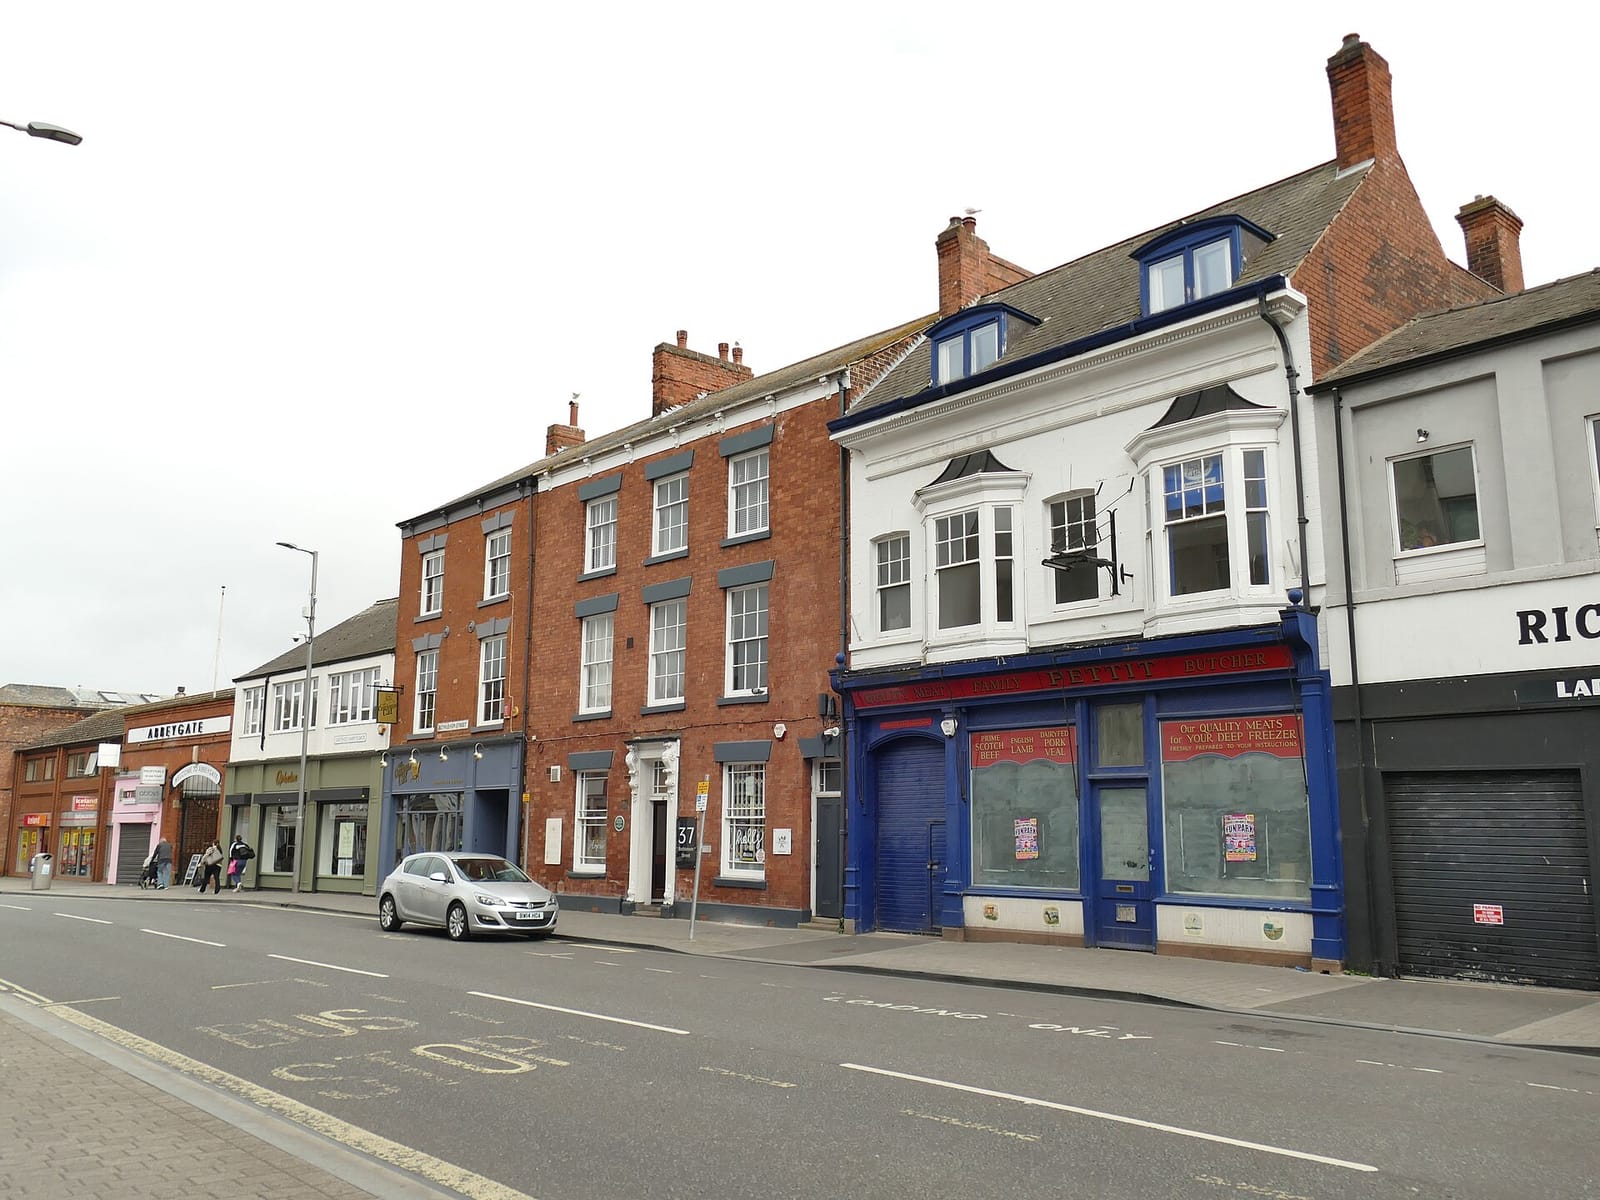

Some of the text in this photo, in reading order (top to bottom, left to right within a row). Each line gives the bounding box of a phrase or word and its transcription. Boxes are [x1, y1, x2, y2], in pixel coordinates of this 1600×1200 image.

[1516, 603, 1600, 645] RIC
[913, 686, 945, 698] MEAT
[973, 676, 1022, 692] FAMILY
[1048, 661, 1154, 686] PETTIT
[1184, 653, 1267, 673] BUTCHER
[147, 721, 204, 739] ABBEYGATE
[1180, 719, 1283, 734] Our QUALITY MEATS
[980, 734, 1001, 742] PRIME
[1010, 736, 1034, 744] ENGLISH
[1044, 738, 1066, 747] PORK
[1170, 729, 1297, 744] for YOUR DEEP FREEZER
[975, 741, 1005, 752] SCOTCH
[1011, 744, 1034, 754] LAMB
[1044, 747, 1065, 756] VEAL
[980, 750, 1000, 760] BEEF
[678, 827, 694, 844] 37
[195, 1008, 419, 1049] BUS
[1029, 1023, 1153, 1040] ONLY
